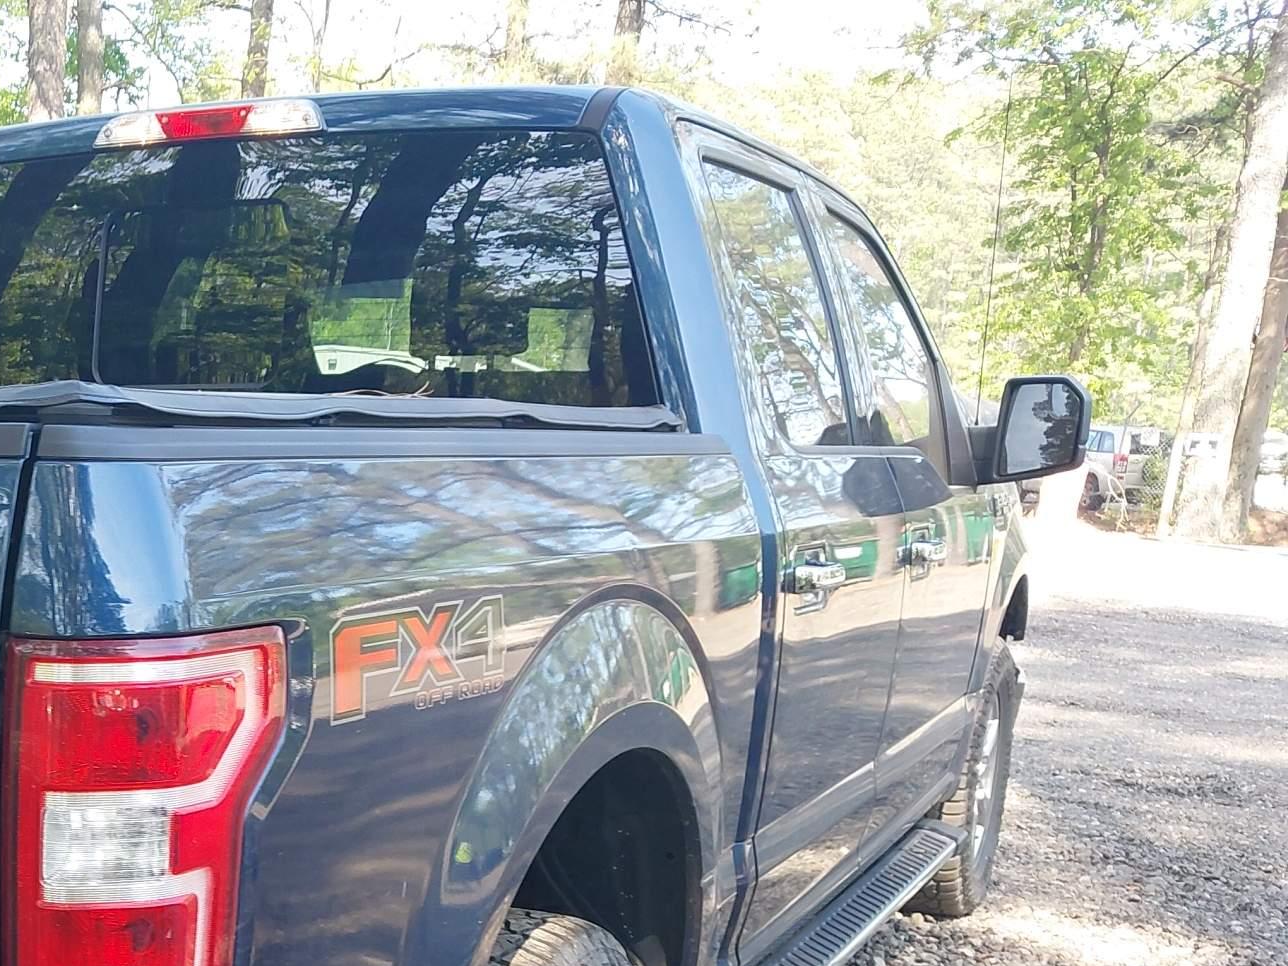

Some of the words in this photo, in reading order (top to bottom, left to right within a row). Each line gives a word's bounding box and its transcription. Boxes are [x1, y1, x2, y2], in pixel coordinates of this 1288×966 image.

[329, 594, 505, 727] FX4
[415, 686, 454, 710] OFF
[457, 674, 505, 701] ROAD
